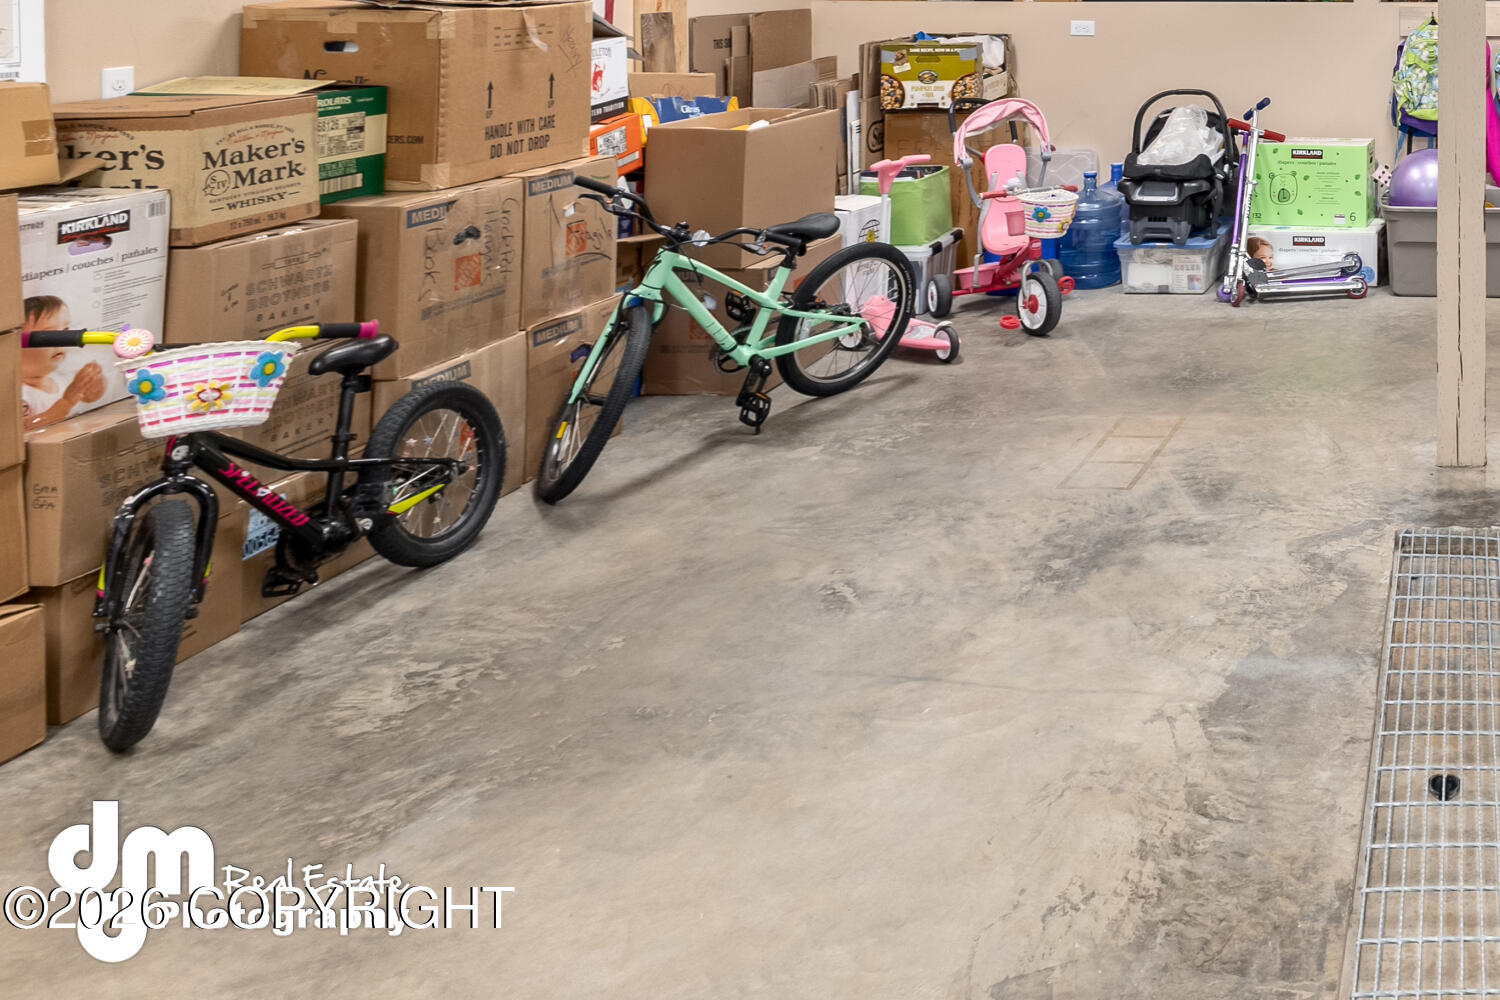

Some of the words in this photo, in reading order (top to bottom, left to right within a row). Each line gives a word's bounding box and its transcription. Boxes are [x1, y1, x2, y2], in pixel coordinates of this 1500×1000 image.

[484, 121, 513, 141] HANDLE
[517, 118, 536, 135] WITH
[538, 114, 556, 131] CARE
[64, 144, 164, 171] ker's
[202, 137, 305, 170] Maker's
[489, 143, 503, 159] DO
[506, 139, 524, 156] NOT
[528, 134, 551, 151] DROP
[232, 160, 304, 189] Mark
[532, 173, 573, 193] MEDIUM
[226, 191, 288, 211] WHISKY
[61, 212, 129, 235] KIRKLAND
[411, 206, 450, 224] MEDI
[1349, 211, 1357, 221] 6
[22, 266, 64, 282] diapers
[72, 256, 114, 271] couches
[121, 246, 158, 262] pañales
[246, 264, 333, 296] SCHWARTZ
[247, 280, 330, 312] BROTHERS
[255, 298, 321, 322] BAKERY
[536, 318, 578, 343] MEDIUM
